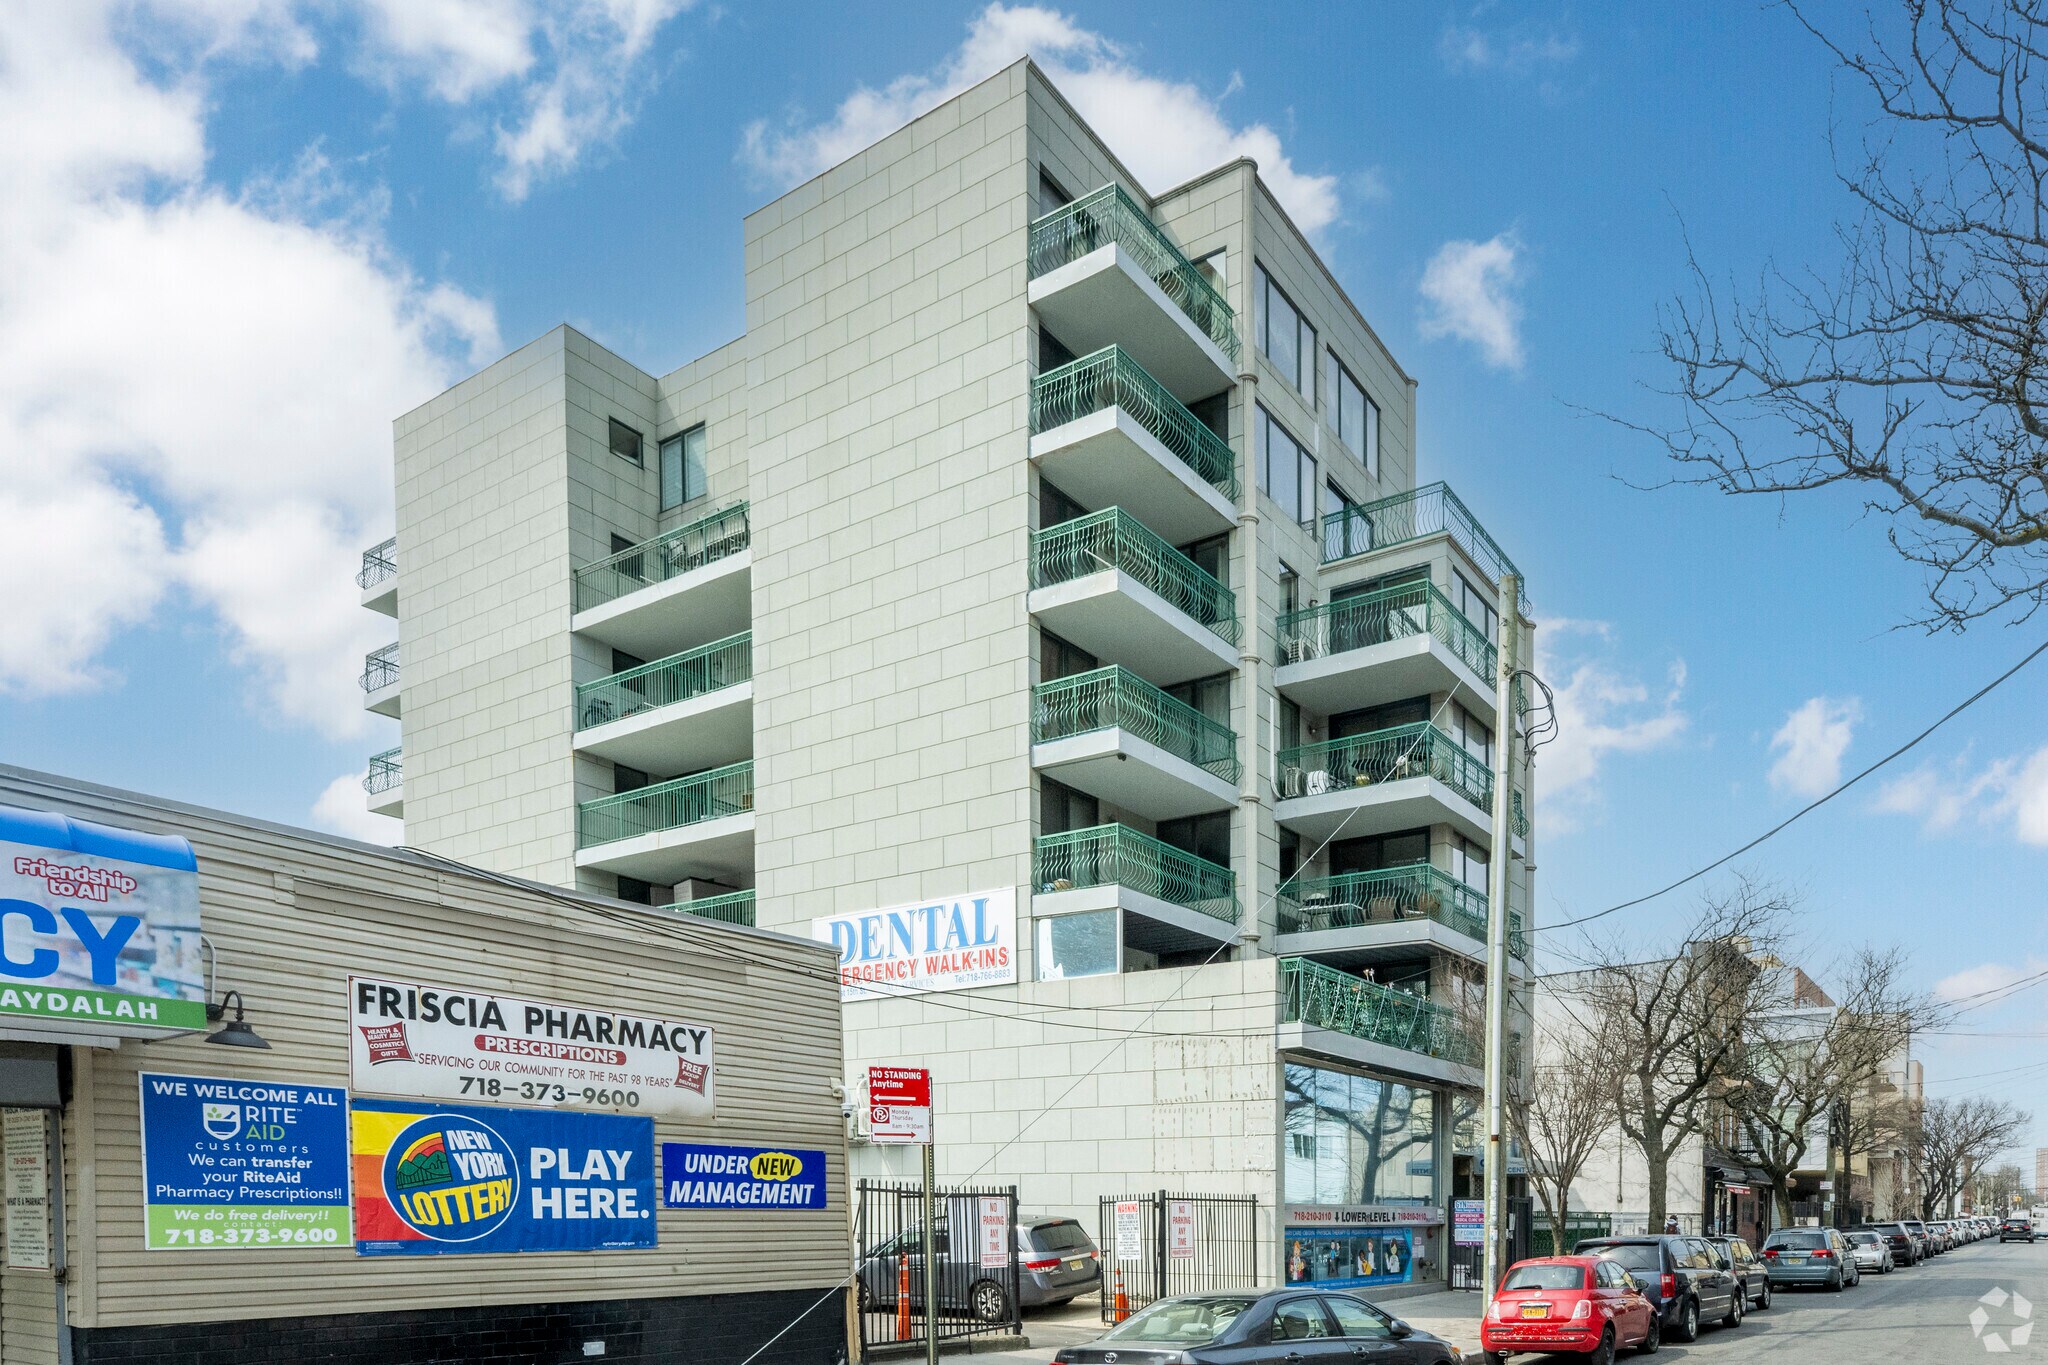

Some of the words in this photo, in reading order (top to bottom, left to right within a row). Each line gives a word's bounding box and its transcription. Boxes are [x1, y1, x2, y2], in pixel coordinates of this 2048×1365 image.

[15, 857, 137, 893] Friendship
[49, 878, 76, 897] to
[76, 881, 108, 902] All
[829, 897, 999, 965] DENTAL
[925, 946, 1010, 975] WALK-INS
[0, 989, 158, 1020] AYDALAH
[358, 983, 507, 1031] FRISCIA
[525, 1006, 707, 1055] PHARMACY
[370, 1041, 405, 1049] COSMETICS
[484, 1036, 618, 1065] PRESCRIPTIONS
[478, 1060, 501, 1072] OUR
[504, 1062, 565, 1078] COMMUNITY
[567, 1068, 586, 1081] FOR
[589, 1071, 606, 1082] THE
[608, 1072, 629, 1085] PAST
[630, 1076, 642, 1086] 98
[681, 1061, 704, 1076] FREE
[871, 1070, 883, 1078] NO
[884, 1071, 922, 1080] STANDING
[459, 1076, 640, 1108] 718-373-9600
[872, 1079, 904, 1089] Anytime
[152, 1080, 188, 1097] WE
[193, 1083, 299, 1104] WELCOME
[304, 1091, 338, 1106] ALL
[245, 1124, 286, 1141] AID
[446, 1129, 492, 1151] NEW
[195, 1141, 309, 1154] customers
[188, 1153, 215, 1167] We
[220, 1157, 247, 1168] can
[251, 1156, 313, 1169] transfer
[452, 1151, 507, 1181] YORK
[530, 1147, 633, 1180] PLAY
[684, 1153, 749, 1175] UNDER
[756, 1157, 796, 1176] NEW
[202, 1172, 238, 1186] your
[243, 1170, 301, 1184] RiteAid
[156, 1184, 235, 1201] Pharmacy
[239, 1186, 342, 1203] Prescriptions!!
[669, 1180, 815, 1205] MANAGEMENT
[399, 1177, 513, 1226] LOTTERY
[531, 1186, 650, 1219] HERE.
[989, 1202, 998, 1212] NO
[1117, 1202, 1138, 1214] WARNING
[1178, 1205, 1186, 1214] NO
[174, 1209, 200, 1221] We
[204, 1209, 224, 1221] do
[228, 1209, 258, 1221] free
[262, 1209, 329, 1224] delivery!!
[223, 1220, 283, 1228] contact:
[982, 1215, 1005, 1226] PARKING
[1172, 1216, 1191, 1225] PARKING
[1294, 1211, 1332, 1221] 718-210-3110
[1341, 1211, 1367, 1223] LOWER
[1370, 1212, 1391, 1223] LEVEL
[165, 1227, 338, 1245] 718-373-9600
[990, 1228, 999, 1239] ANY
[1178, 1227, 1186, 1236] ANY
[989, 1241, 1000, 1252] TIME
[1177, 1237, 1187, 1246] TIME
